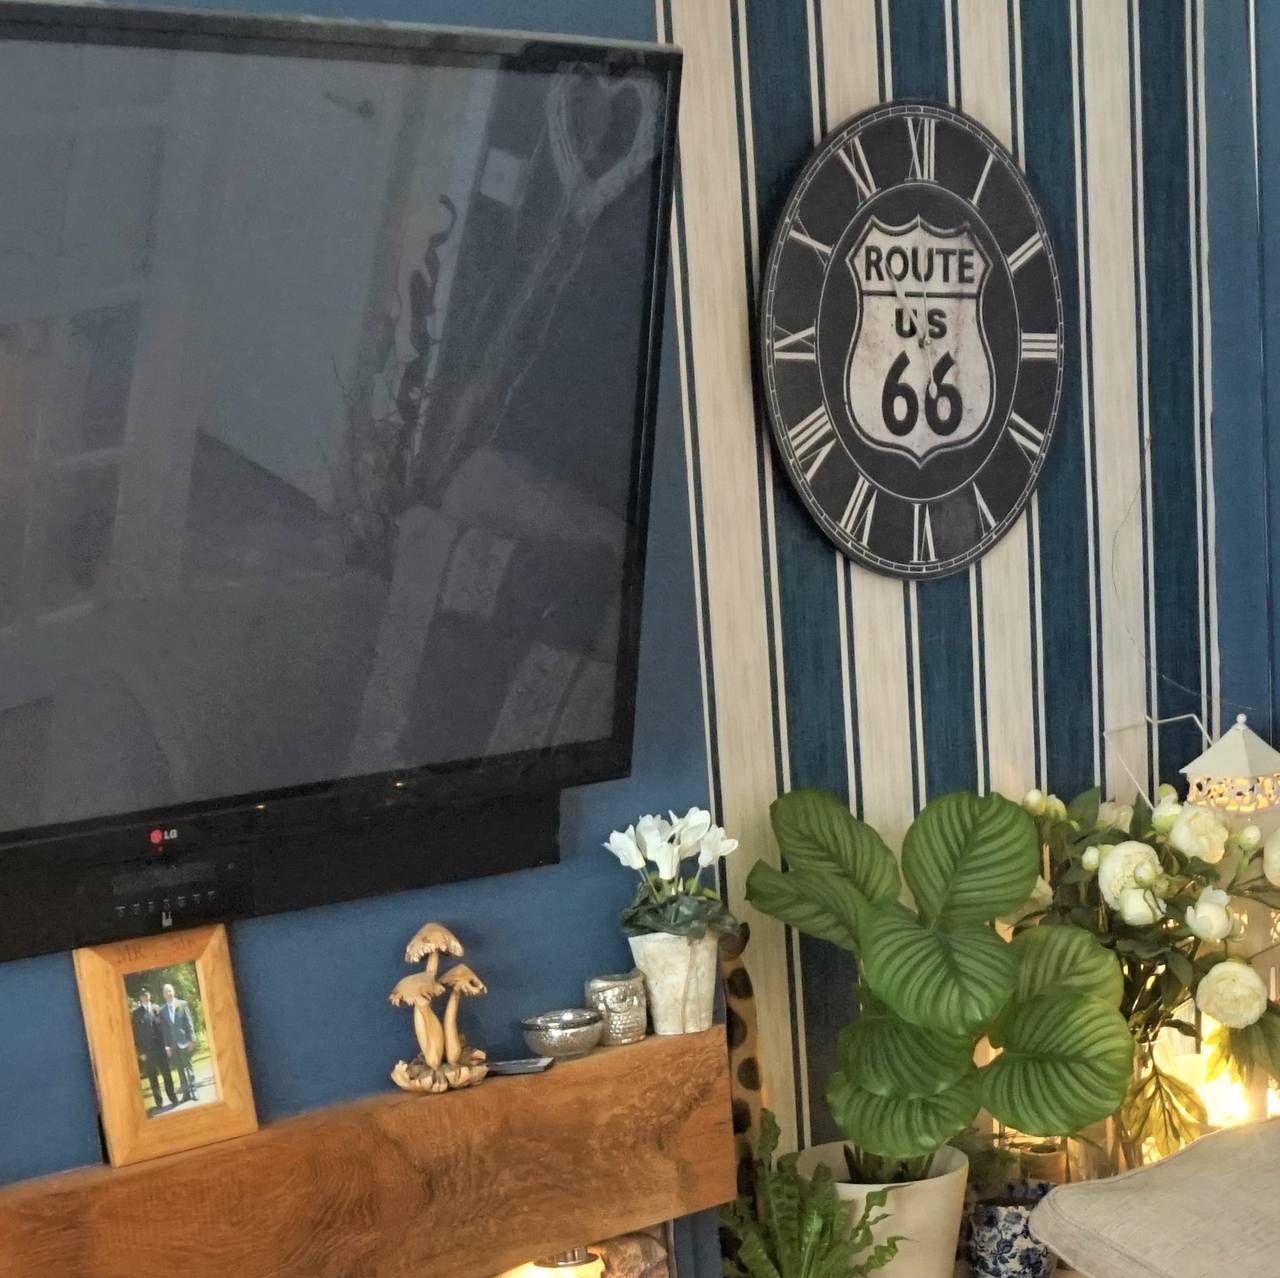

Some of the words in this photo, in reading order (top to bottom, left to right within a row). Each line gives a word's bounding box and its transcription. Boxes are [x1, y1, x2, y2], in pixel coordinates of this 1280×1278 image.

[865, 245, 974, 283] ROUTE
[895, 308, 948, 340] US
[882, 350, 964, 437] 66
[164, 829, 178, 840] LG
